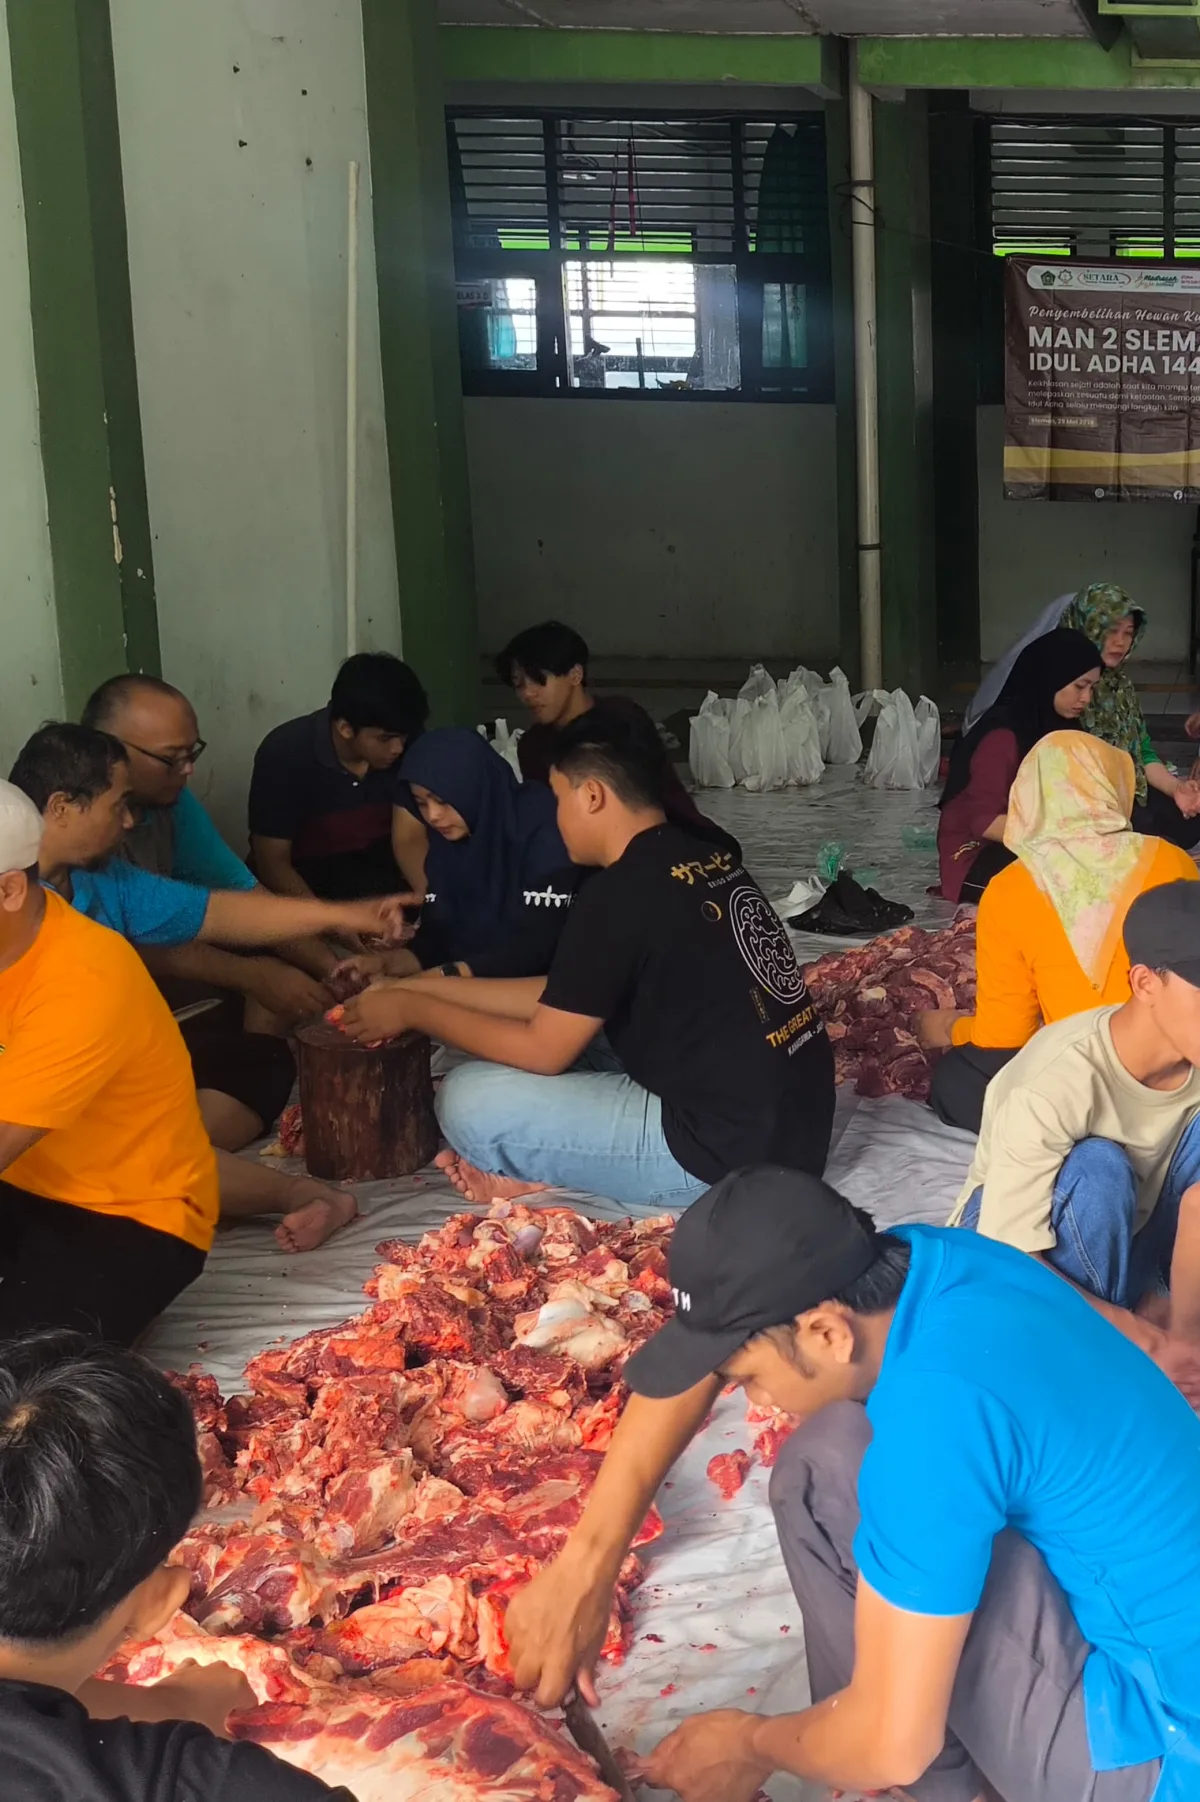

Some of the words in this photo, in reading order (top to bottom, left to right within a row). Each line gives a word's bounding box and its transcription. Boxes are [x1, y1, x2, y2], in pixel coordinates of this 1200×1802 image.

[456, 291, 475, 300] ELAS
[1028, 305, 1131, 323] Penyembelihan
[1135, 308, 1180, 322] Hewan
[1029, 326, 1094, 349] MAN
[1102, 327, 1117, 349] 2
[1029, 353, 1080, 371] IDUL
[1087, 354, 1155, 374] ADHA
[1157, 384, 1188, 392] mampu
[765, 1024, 790, 1048] THE
[788, 1006, 813, 1034] GREAT
